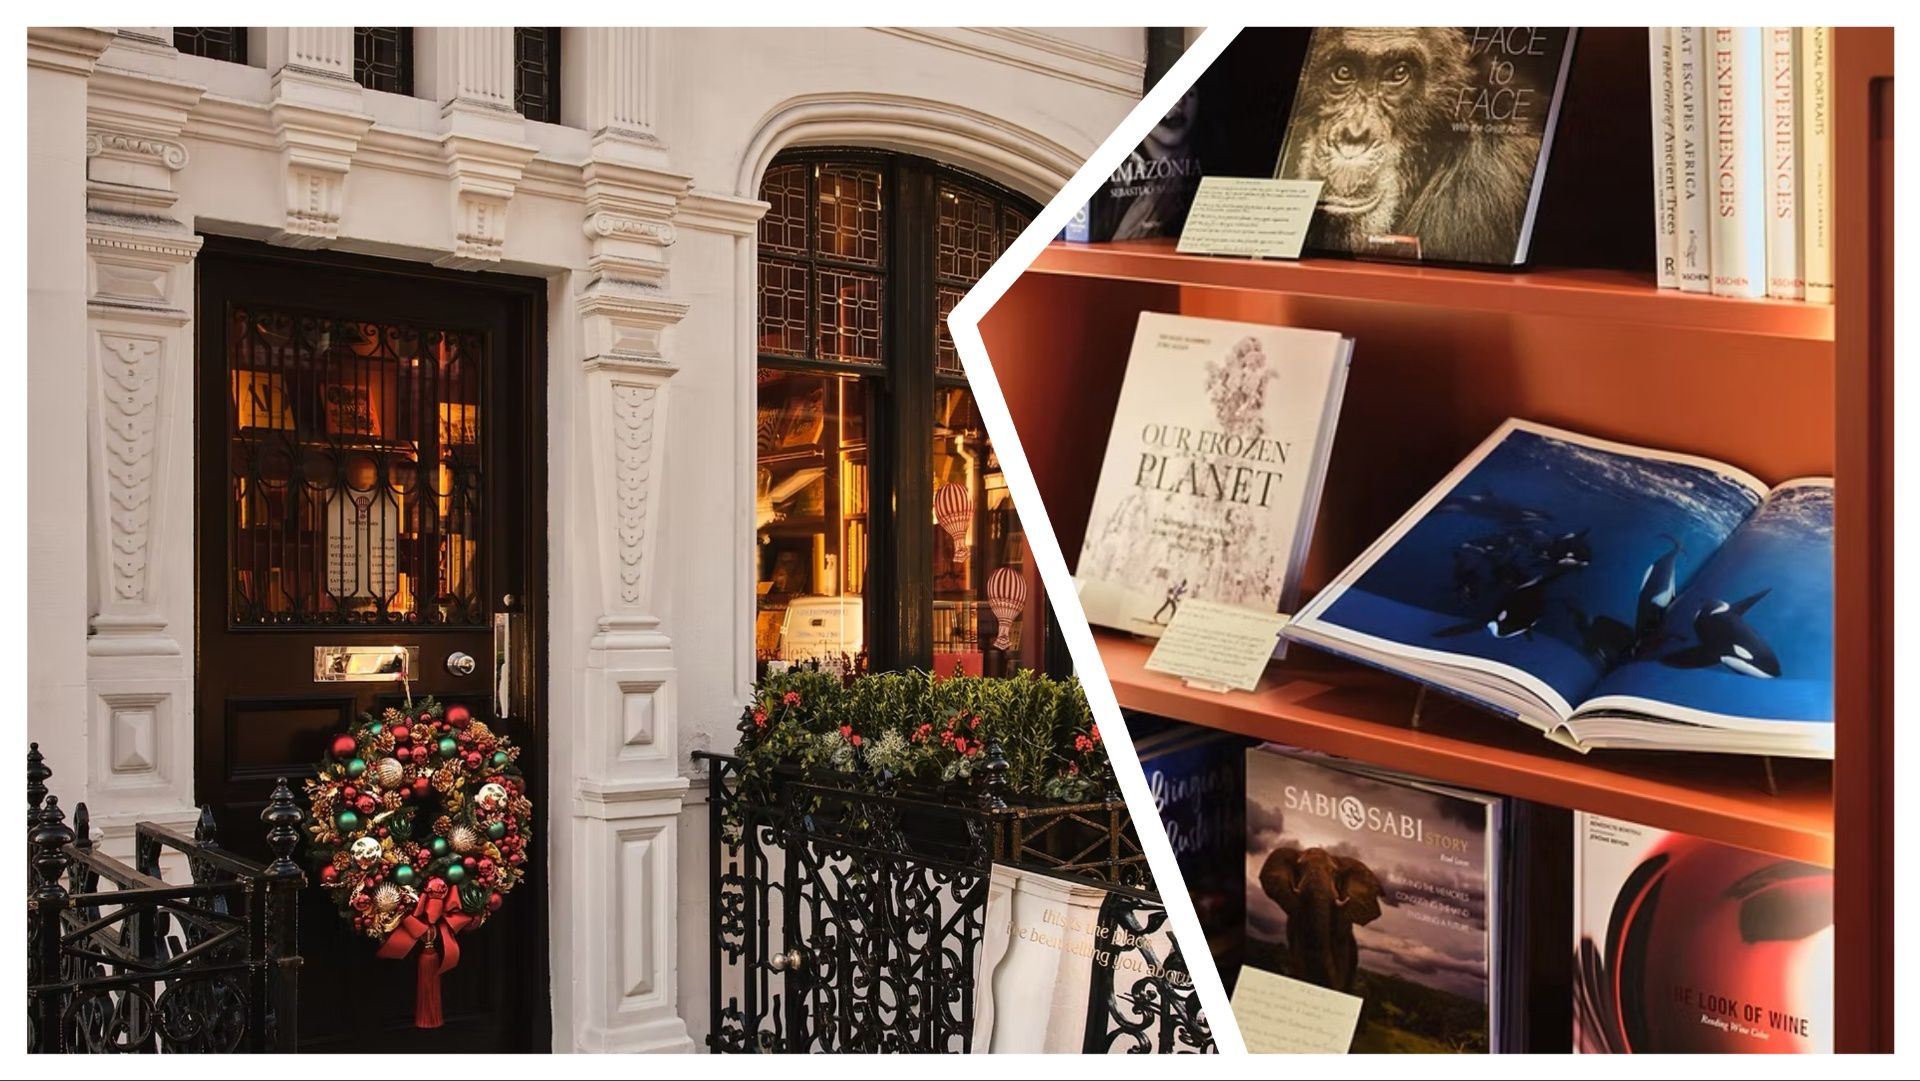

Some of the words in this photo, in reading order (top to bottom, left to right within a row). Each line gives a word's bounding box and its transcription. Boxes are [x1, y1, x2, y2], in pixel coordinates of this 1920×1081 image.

[1470, 27, 1547, 55] FACE
[1488, 56, 1515, 85] to
[1454, 87, 1535, 120] FACE
[1663, 80, 1675, 114] Circle
[1682, 62, 1695, 138] ESCAPES
[1815, 71, 1825, 136] PORTRAITS
[1716, 51, 1735, 218] EXPERIENCES
[1775, 51, 1792, 219] EXPERIENCES
[1664, 131, 1676, 190] Ancient
[1684, 140, 1696, 200] AFRICA
[1665, 195, 1678, 236] Trees
[1141, 423, 1191, 451] OUR
[1198, 431, 1292, 464] FROZEN
[1134, 453, 1283, 508] PLANET
[1151, 766, 1229, 814] Bringin
[1284, 786, 1337, 820] SABI
[1367, 808, 1423, 842] SABI
[1425, 831, 1469, 853] STORY
[1030, 928, 1062, 950] been
[1066, 939, 1111, 967] telling
[1112, 953, 1142, 972] you
[1043, 909, 1066, 928] this
[1070, 917, 1080, 932] is
[1086, 921, 1109, 939] the
[1111, 928, 1152, 948] place
[1699, 992, 1738, 1019] LOOK
[1744, 1003, 1763, 1024] OF
[1768, 1010, 1809, 1038] WINE
[1701, 1014, 1730, 1032] Reading
